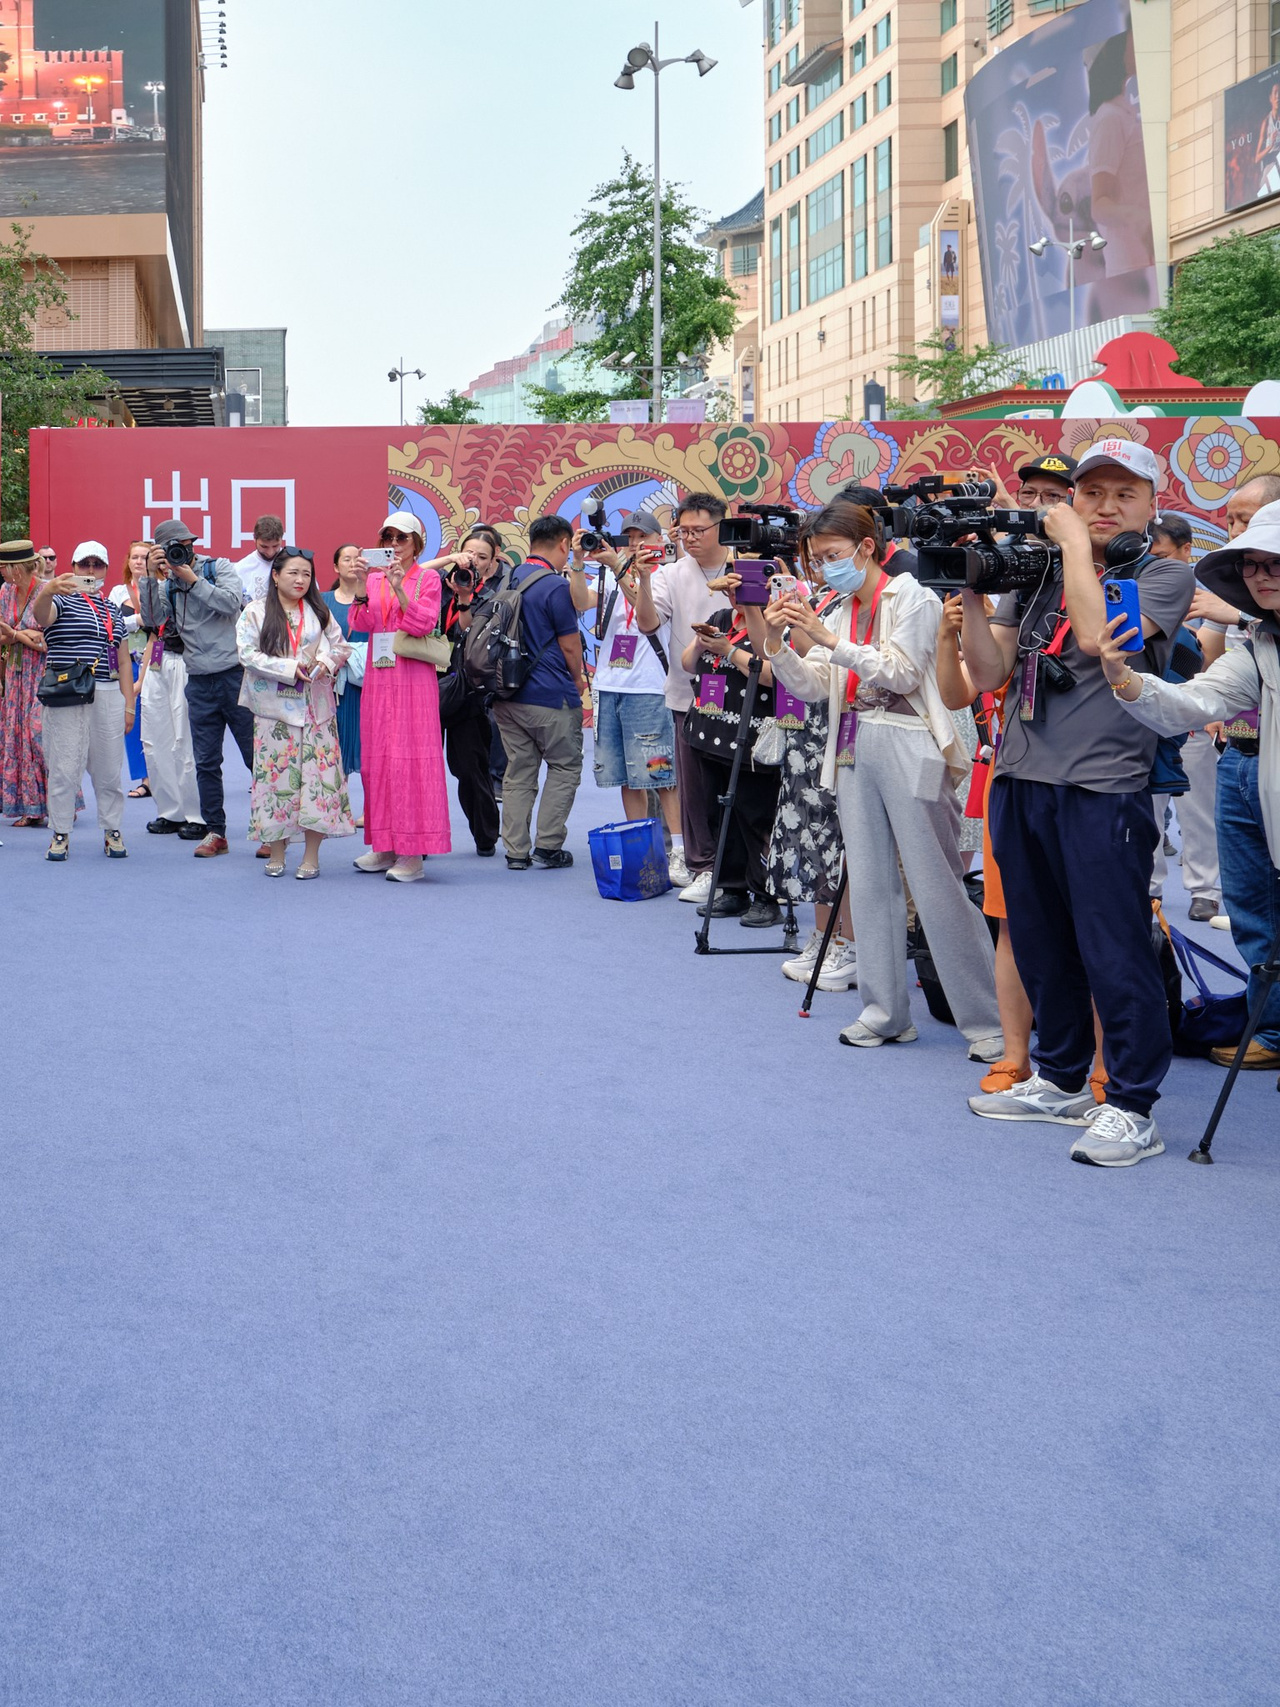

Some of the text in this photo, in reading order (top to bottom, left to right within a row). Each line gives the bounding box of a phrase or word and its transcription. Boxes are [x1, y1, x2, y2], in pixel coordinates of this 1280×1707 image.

[1231, 132, 1253, 150] YOU
[142, 471, 296, 549] 出口
[641, 745, 672, 759] PARIS
